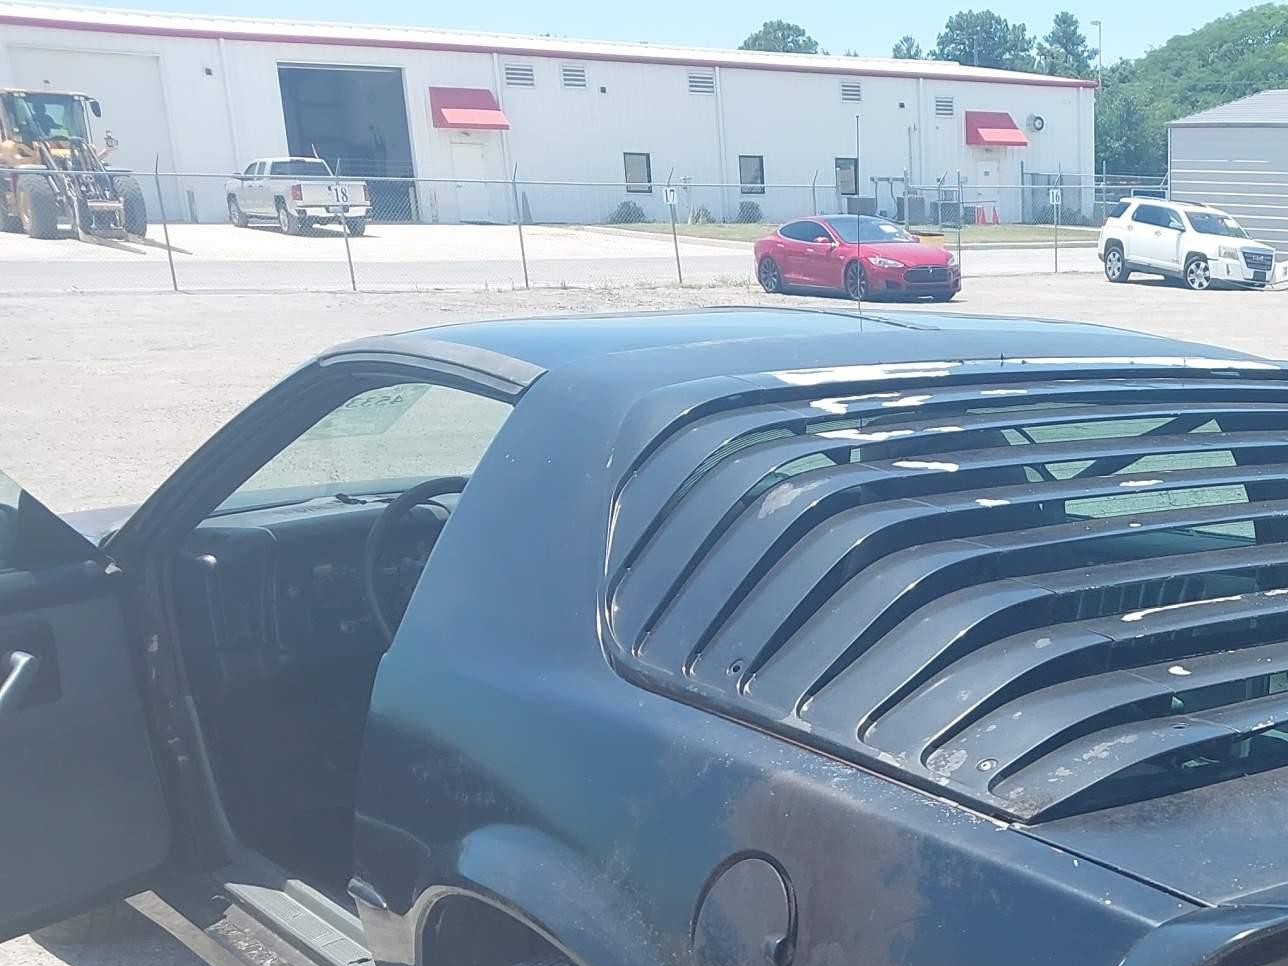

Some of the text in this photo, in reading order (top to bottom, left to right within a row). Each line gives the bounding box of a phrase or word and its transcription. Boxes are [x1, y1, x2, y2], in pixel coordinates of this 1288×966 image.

[334, 187, 348, 202] 18
[665, 189, 675, 202] 17
[1051, 190, 1060, 203] 16
